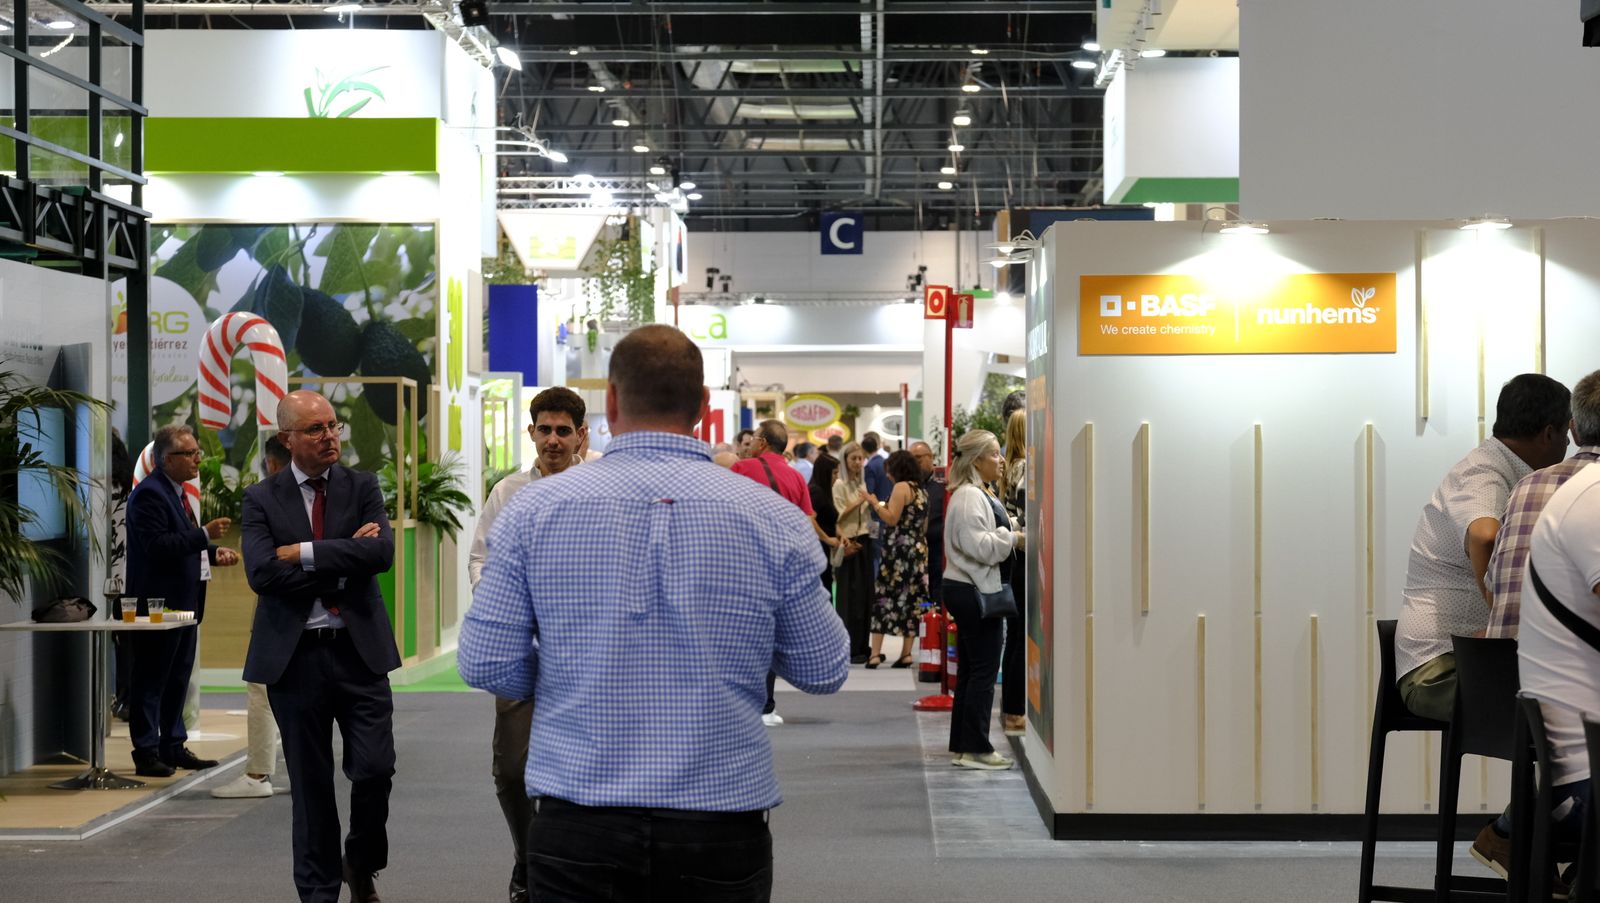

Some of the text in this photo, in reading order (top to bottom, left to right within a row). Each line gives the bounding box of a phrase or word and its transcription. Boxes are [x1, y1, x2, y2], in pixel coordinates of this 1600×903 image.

[829, 217, 855, 249] C
[1141, 294, 1216, 317] BASF
[1256, 303, 1378, 324] nunhems
[1100, 323, 1216, 337] We create chemistry
